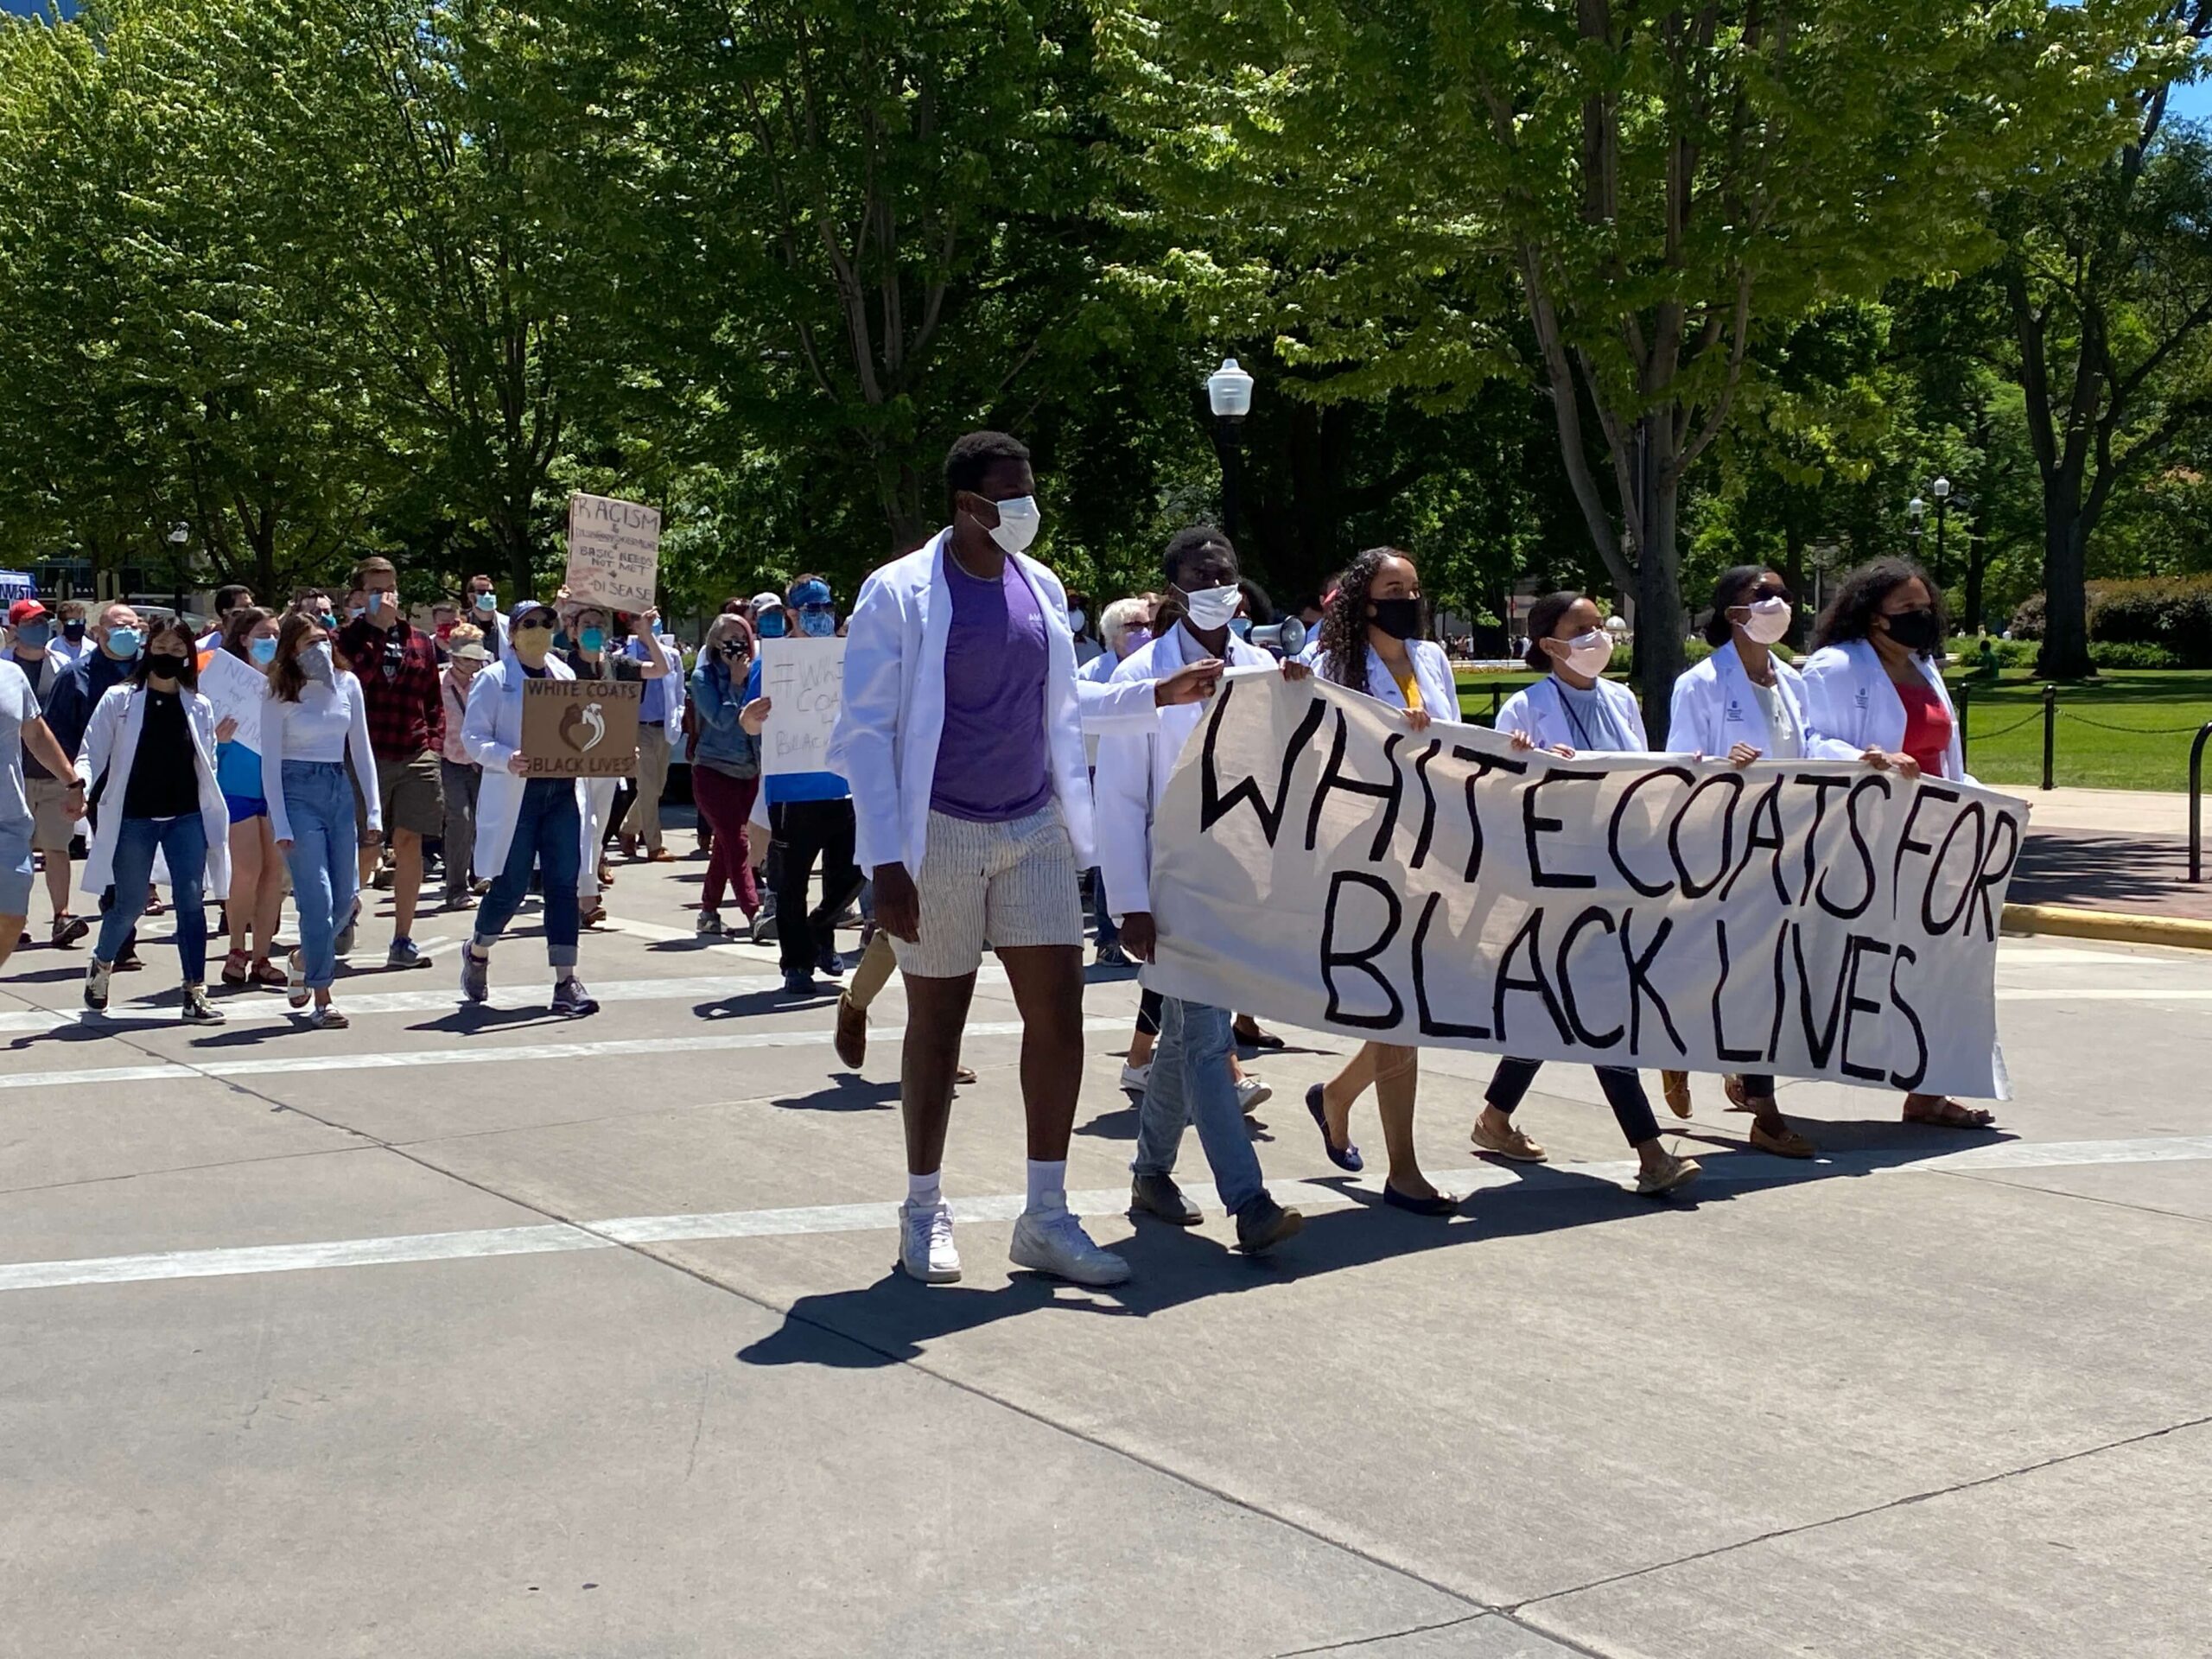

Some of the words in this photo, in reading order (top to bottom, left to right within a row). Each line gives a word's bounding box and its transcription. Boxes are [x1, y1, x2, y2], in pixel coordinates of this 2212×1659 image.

[579, 498, 658, 532] RACISM
[580, 545, 616, 560] BASIC
[619, 552, 654, 567] NEEDS
[591, 558, 613, 569] NOT
[619, 563, 649, 576] MET
[593, 580, 652, 602] DISEASE
[528, 681, 581, 697] WHITE
[586, 683, 638, 699] COATS
[532, 756, 583, 772] BLACK
[588, 756, 632, 772] LIVES
[1199, 680, 1609, 888] WHITE
[1608, 766, 1892, 920] COATS
[1892, 784, 2018, 943] FOR
[1320, 870, 1688, 1056] BLACK
[1712, 918, 1929, 1091] LIVES
